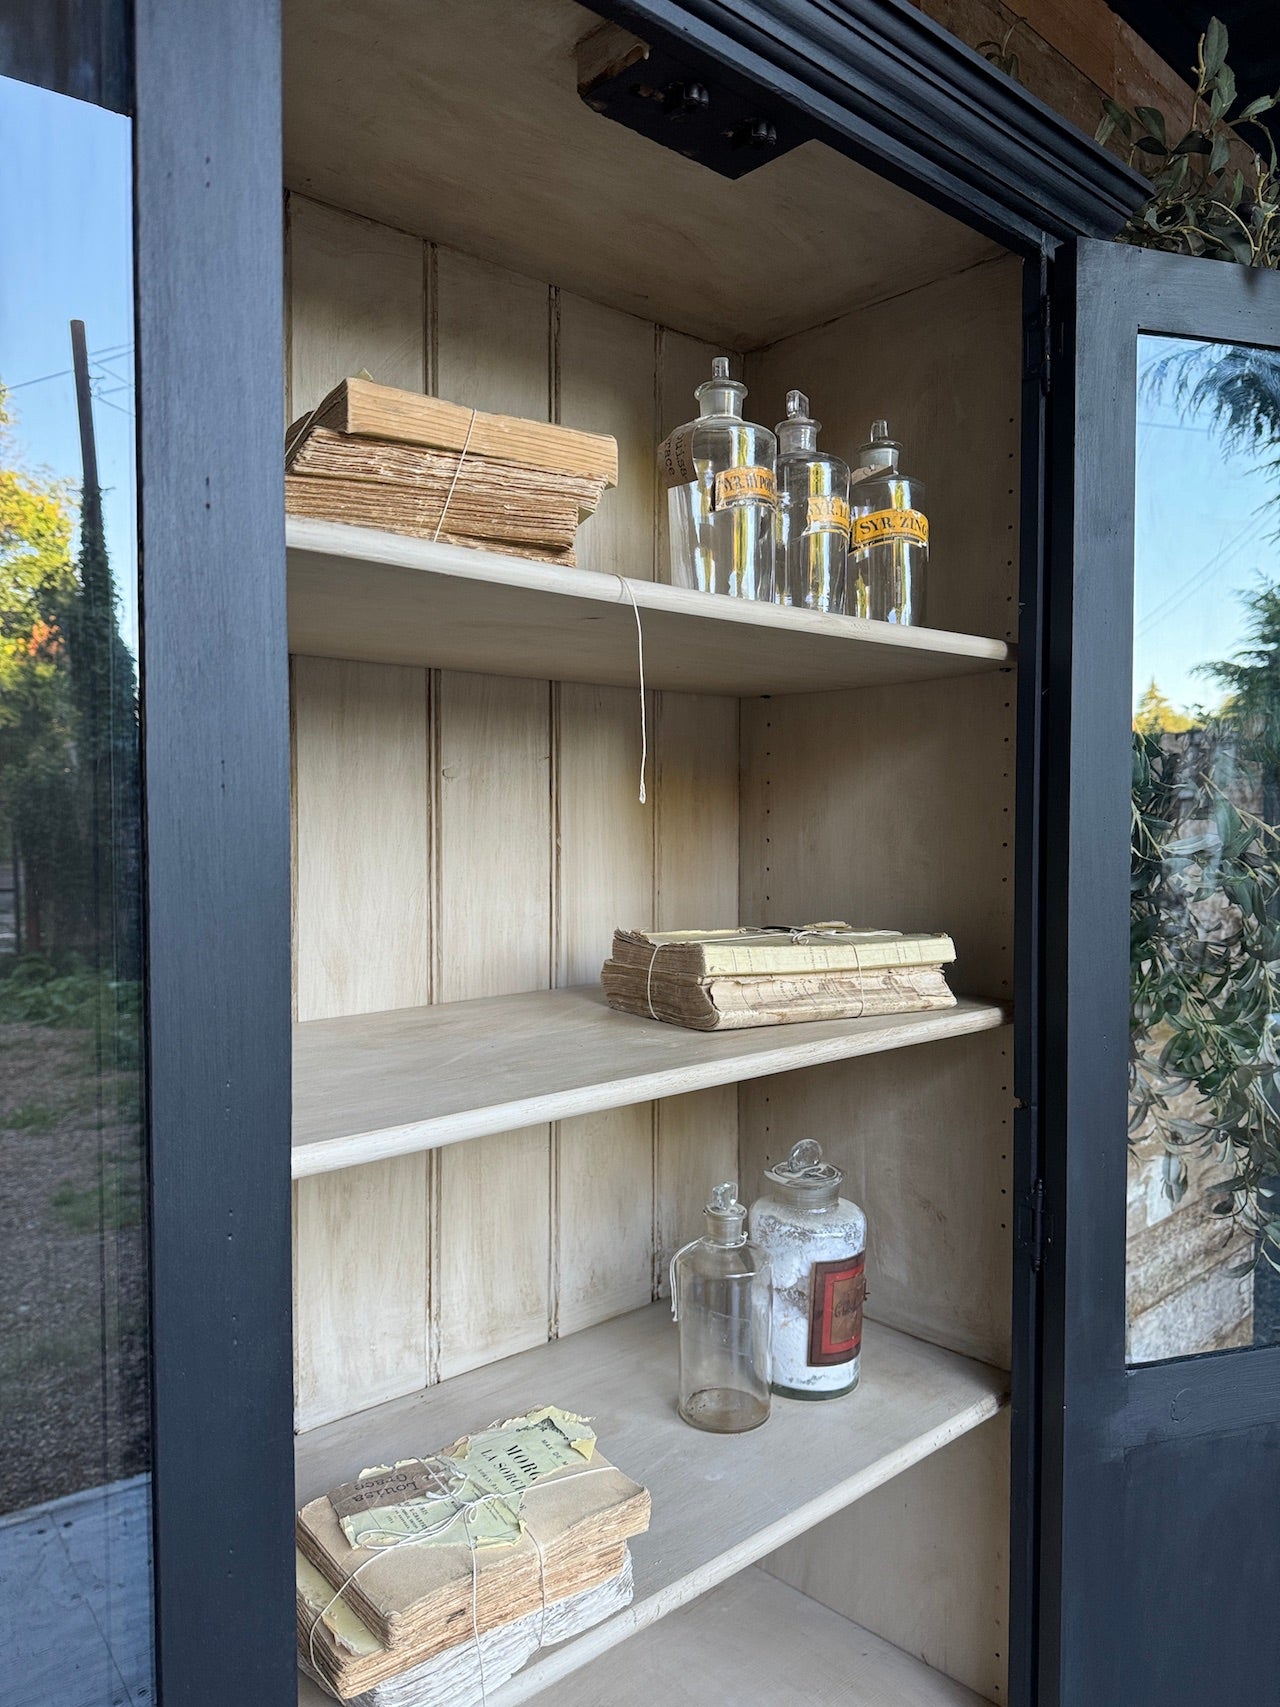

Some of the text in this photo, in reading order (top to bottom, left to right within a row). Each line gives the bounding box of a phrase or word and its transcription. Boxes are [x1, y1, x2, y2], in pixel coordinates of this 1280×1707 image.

[859, 514, 896, 534] SYR.
[352, 1480, 420, 1503] Louisa
[353, 1473, 407, 1491] Grace
